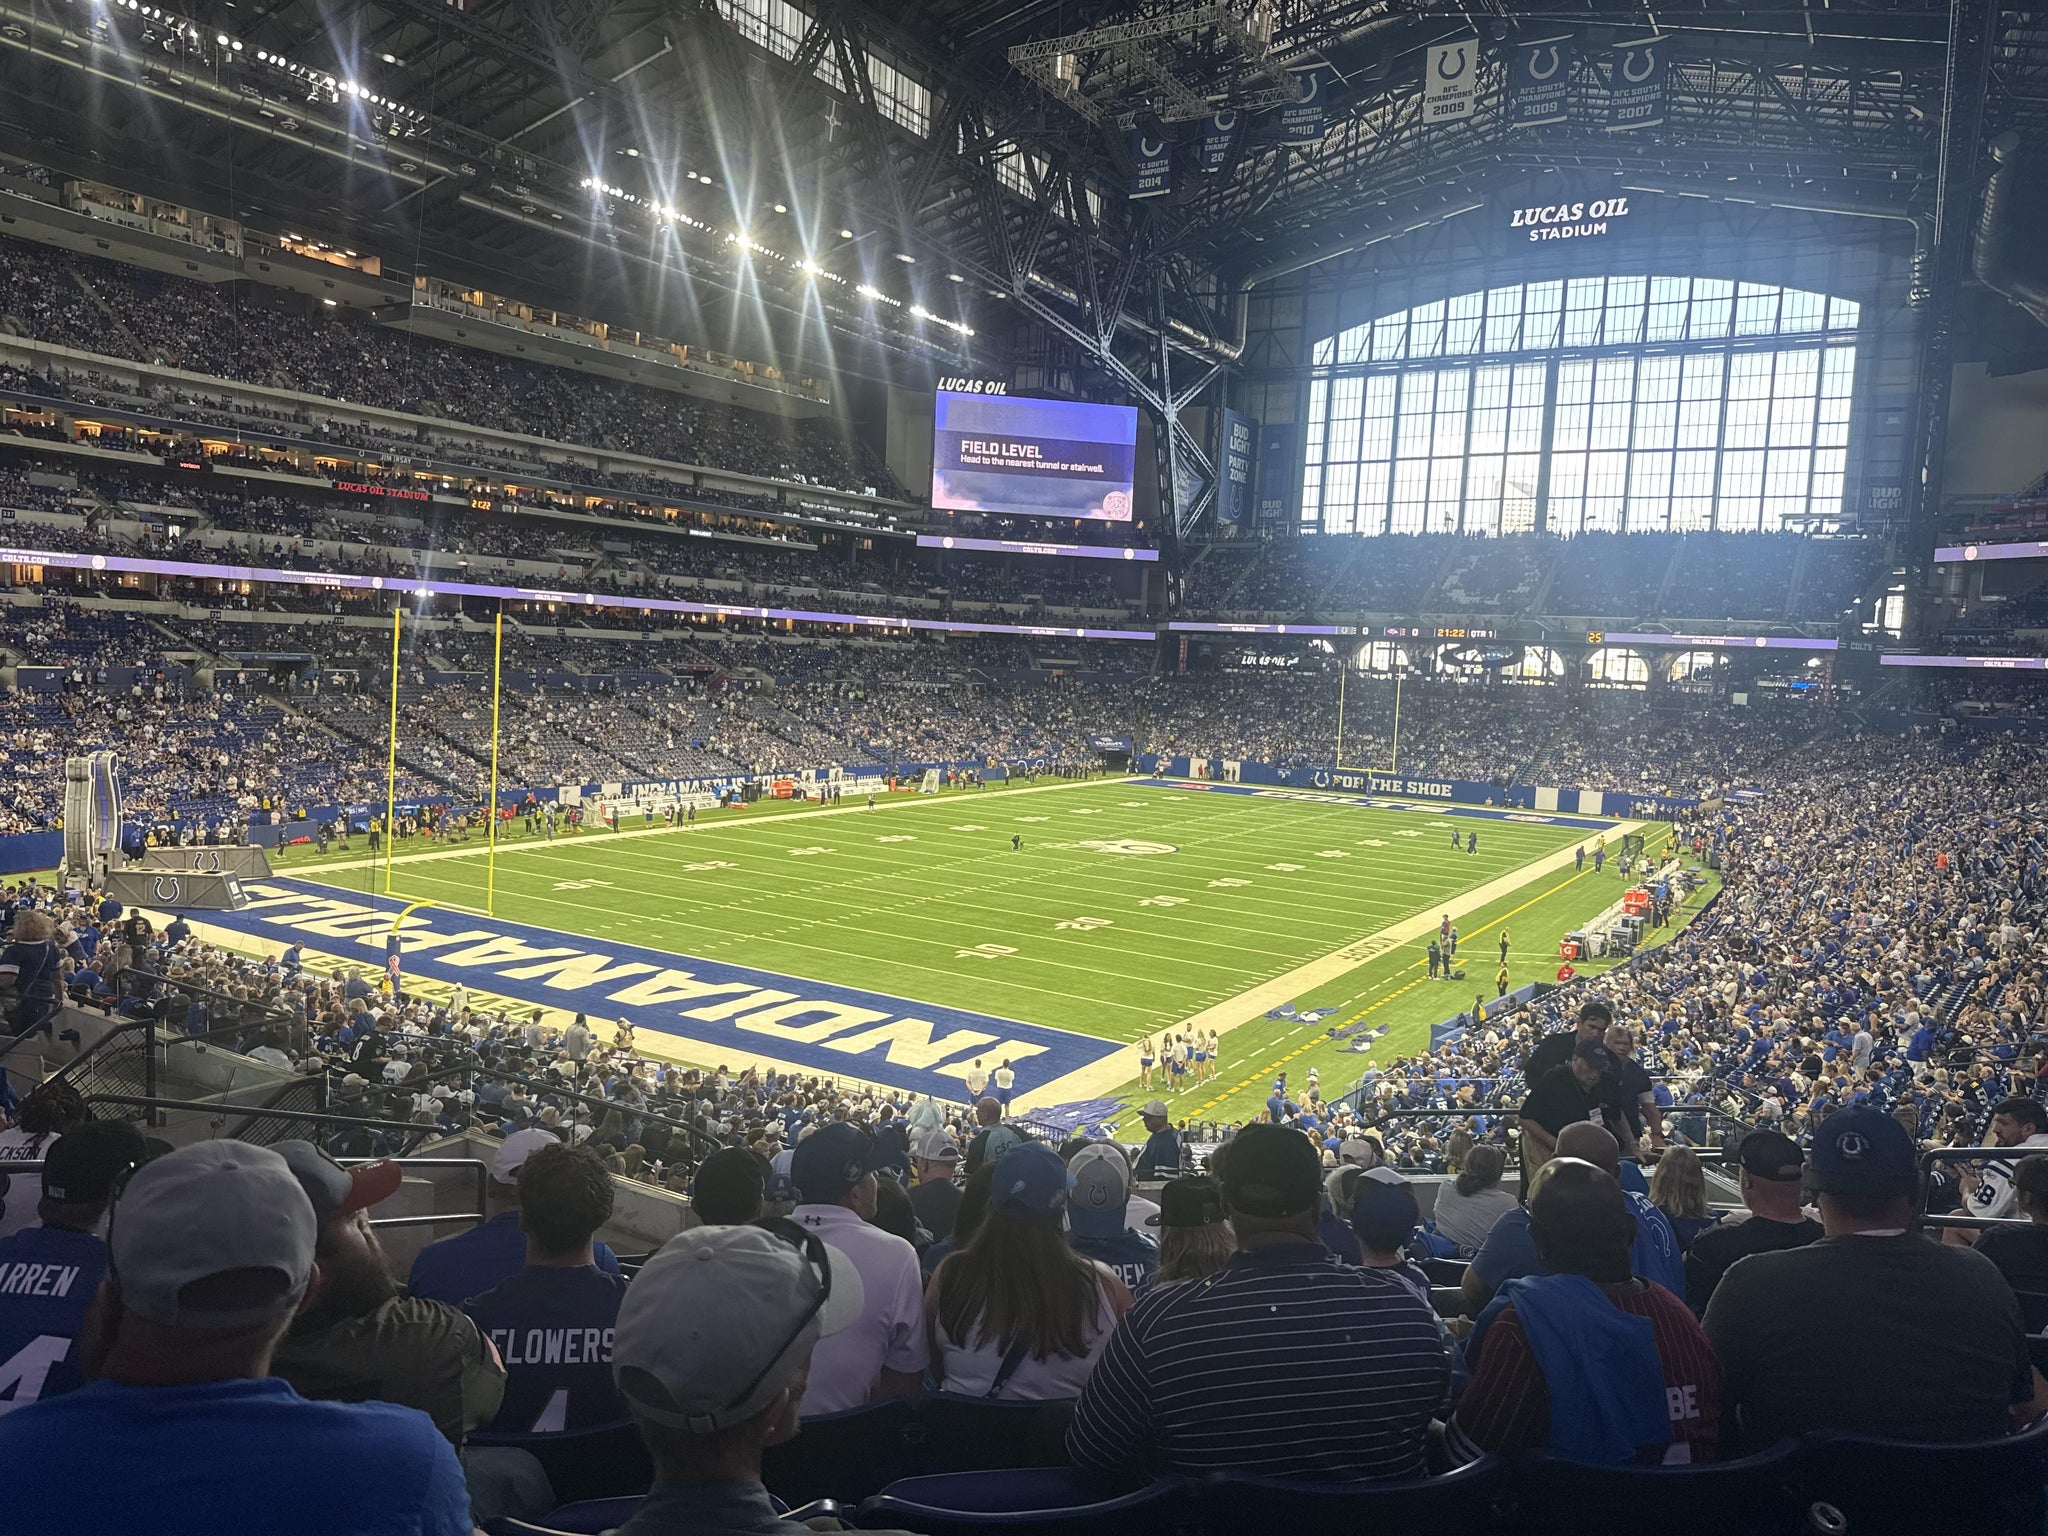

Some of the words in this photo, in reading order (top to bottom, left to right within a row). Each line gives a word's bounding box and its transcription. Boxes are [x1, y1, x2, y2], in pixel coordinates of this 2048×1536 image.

[1442, 84, 1458, 93] AFC
[1519, 86, 1535, 95] AFC
[1537, 82, 1565, 93] SOUTH
[1613, 89, 1630, 98] AFC
[1631, 83, 1661, 95] SOUTH
[1426, 90, 1473, 104] CHAMPIONS
[1517, 90, 1567, 103] CHAMPIONS
[1611, 91, 1662, 106] CHAMPIONS
[1283, 109, 1297, 117] AFC
[1298, 106, 1322, 116] SOUTH
[1432, 102, 1465, 116] 2009
[1523, 102, 1558, 116] 2009
[1617, 104, 1653, 119] 2007
[1281, 113, 1323, 124] CHAMPIONS
[1204, 142, 1230, 151] CHAMP
[1206, 136, 1220, 144] AFC
[1147, 159, 1169, 168] SOUTH
[1138, 166, 1170, 176] AMPIONS
[1138, 176, 1162, 189] 2014
[1510, 203, 1584, 227] LUCAS
[1589, 198, 1629, 218] OIL
[1529, 222, 1607, 241] STADIUM
[937, 377, 982, 394] LUCAS
[984, 381, 1007, 396] OIL
[1233, 423, 1249, 439] BUD
[961, 440, 999, 455] FIELD
[1002, 443, 1043, 459] LEVEL
[1230, 437, 1251, 455] LIGHT
[380, 454, 395, 462] JIM
[395, 456, 412, 465] IRSAY
[960, 454, 981, 464] Head
[982, 457, 990, 465] to
[991, 457, 1004, 466] the
[1005, 459, 1035, 468] nearest
[1036, 460, 1059, 470] tunnel
[1228, 454, 1250, 472] PARTY
[1229, 469, 1247, 484] ZONE
[338, 482, 368, 494] LUCAS
[369, 486, 385, 496] OIL
[386, 488, 429, 501] STADIUM
[1872, 487, 1902, 498] BUD
[1262, 500, 1282, 509] BUD
[1868, 497, 1903, 509] LIGHT
[2, 510, 15, 518] 337
[1022, 546, 1057, 555] COLTS.COM
[2, 554, 50, 565] COLTS.COM
[304, 576, 341, 585] COLTS.COM
[1362, 627, 1368, 635] 0
[1411, 628, 1418, 637] 0
[1437, 628, 1465, 637] 21:22
[1470, 629, 1486, 638] QTR
[1488, 629, 1493, 638] 1
[1588, 632, 1602, 643] 25
[1850, 642, 1873, 651] COLTS
[1371, 779, 1403, 793] THE
[1406, 780, 1452, 797] SHOE
[1251, 790, 1454, 813] COLTS
[956, 943, 1019, 959] 10
[1563, 946, 1572, 954] G
[352, 1041, 363, 1061] 8
[1643, 1056, 1655, 1069] 21
[1975, 1086, 1988, 1106] 5
[994, 1140, 1013, 1155] CSC
[491, 1328, 616, 1364] FLOWERS
